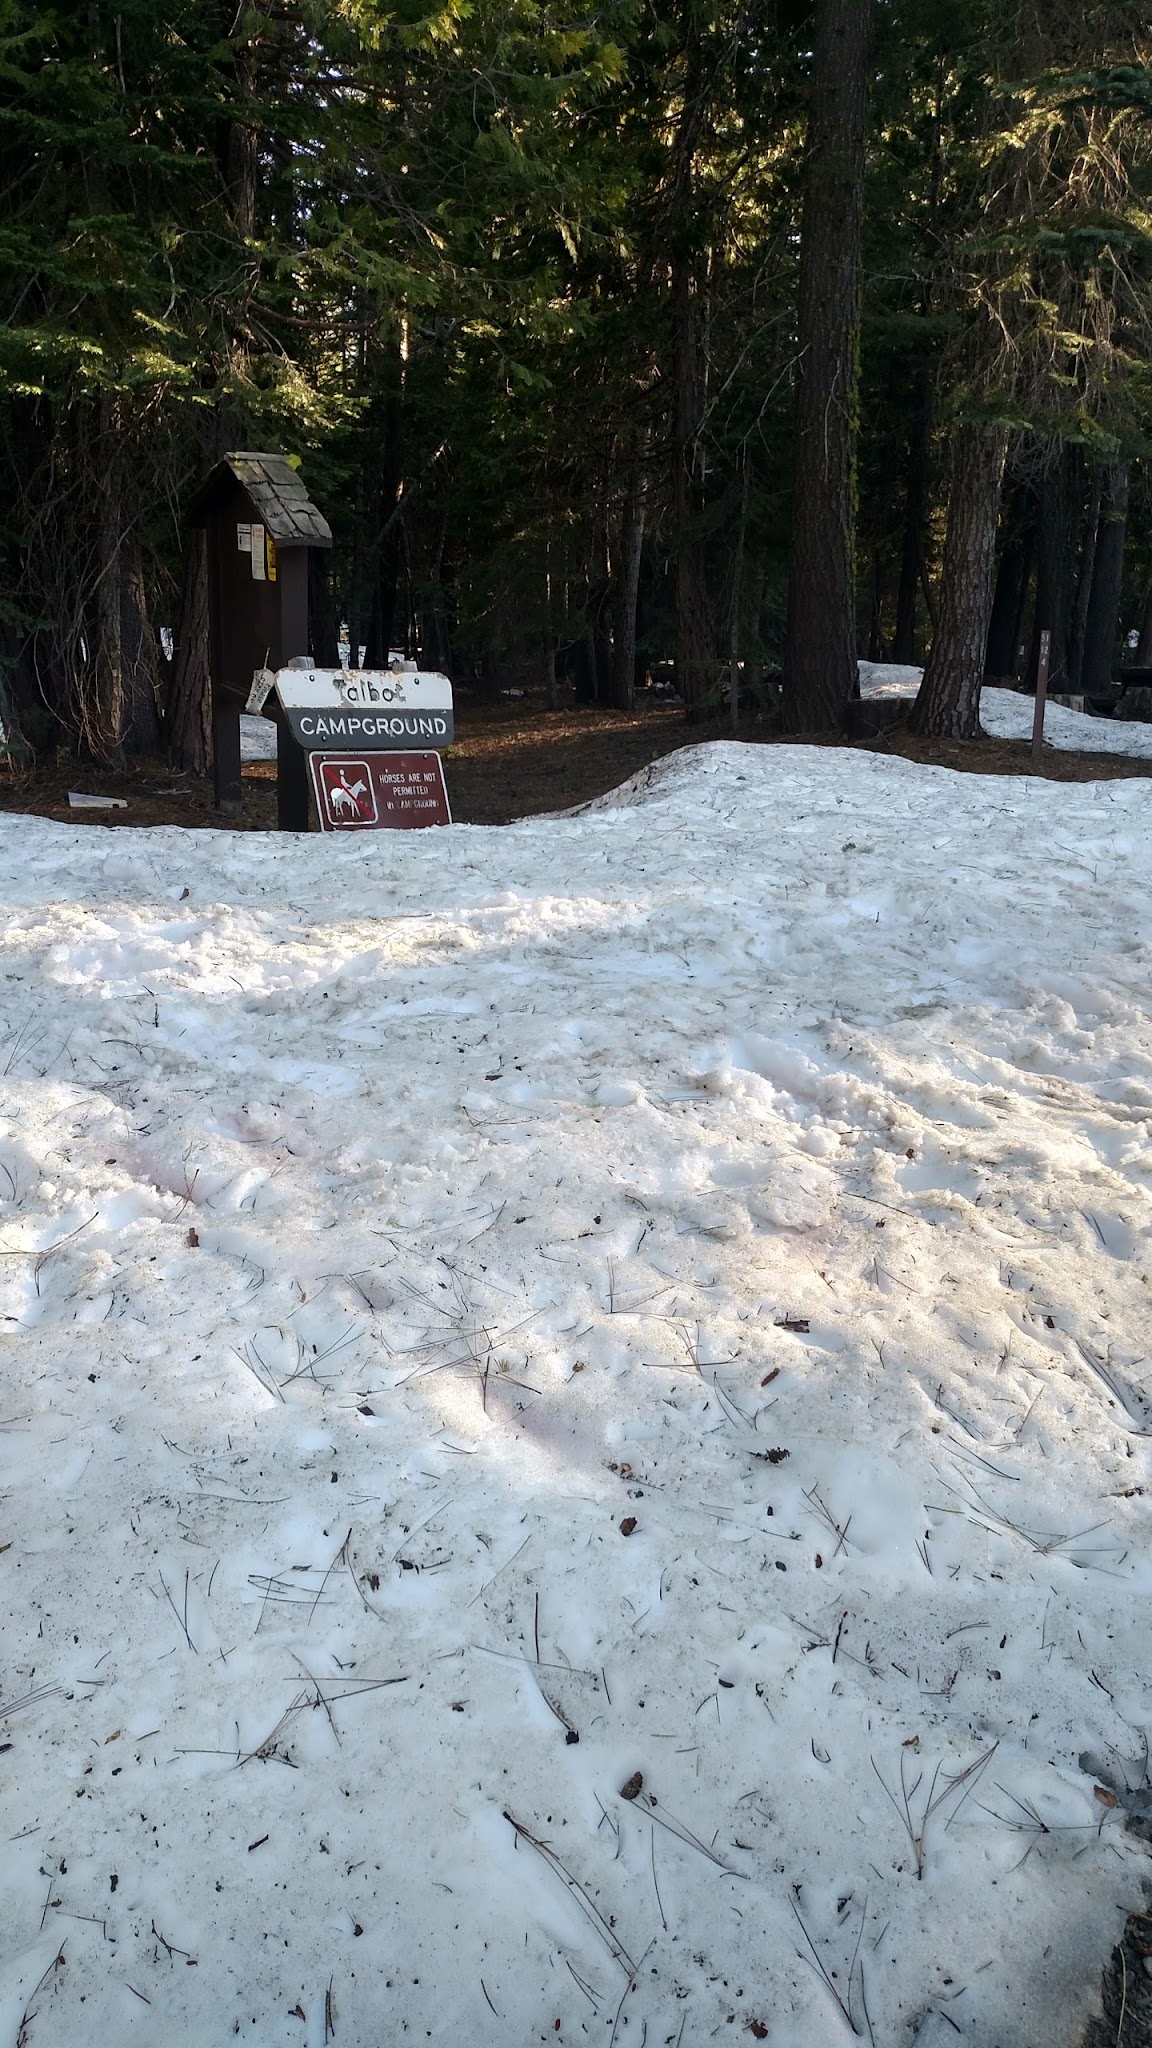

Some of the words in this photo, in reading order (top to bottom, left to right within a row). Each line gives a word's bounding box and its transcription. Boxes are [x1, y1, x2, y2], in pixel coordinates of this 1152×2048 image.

[1041, 633, 1049, 642] 51
[1040, 646, 1048, 654] 12
[1040, 658, 1046, 667] 4
[299, 716, 447, 736] CAMPGROUND
[379, 773, 405, 783] HORSES
[408, 773, 421, 783] ARE
[424, 772, 436, 782] NOT
[392, 786, 429, 796] PERMITTED
